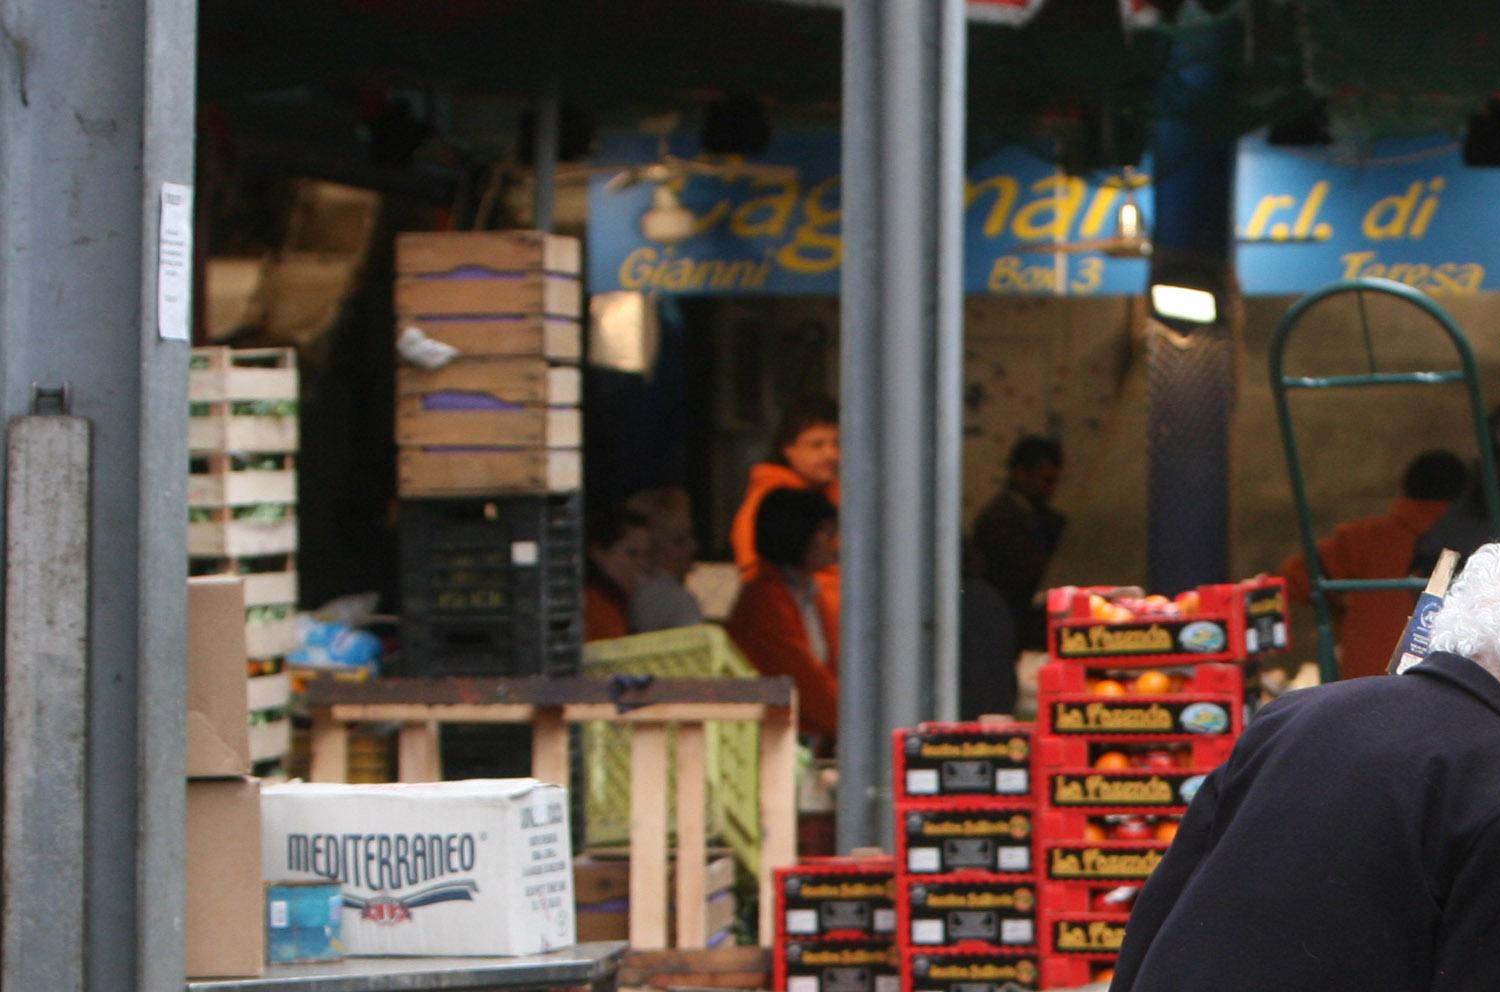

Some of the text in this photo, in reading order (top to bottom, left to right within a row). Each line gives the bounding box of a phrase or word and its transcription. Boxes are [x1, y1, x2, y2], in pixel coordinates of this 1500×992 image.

[1362, 176, 1445, 239] di
[618, 247, 772, 291] Gianni
[988, 256, 1104, 291] Box 3
[287, 833, 475, 891] MEDITERRANEO
